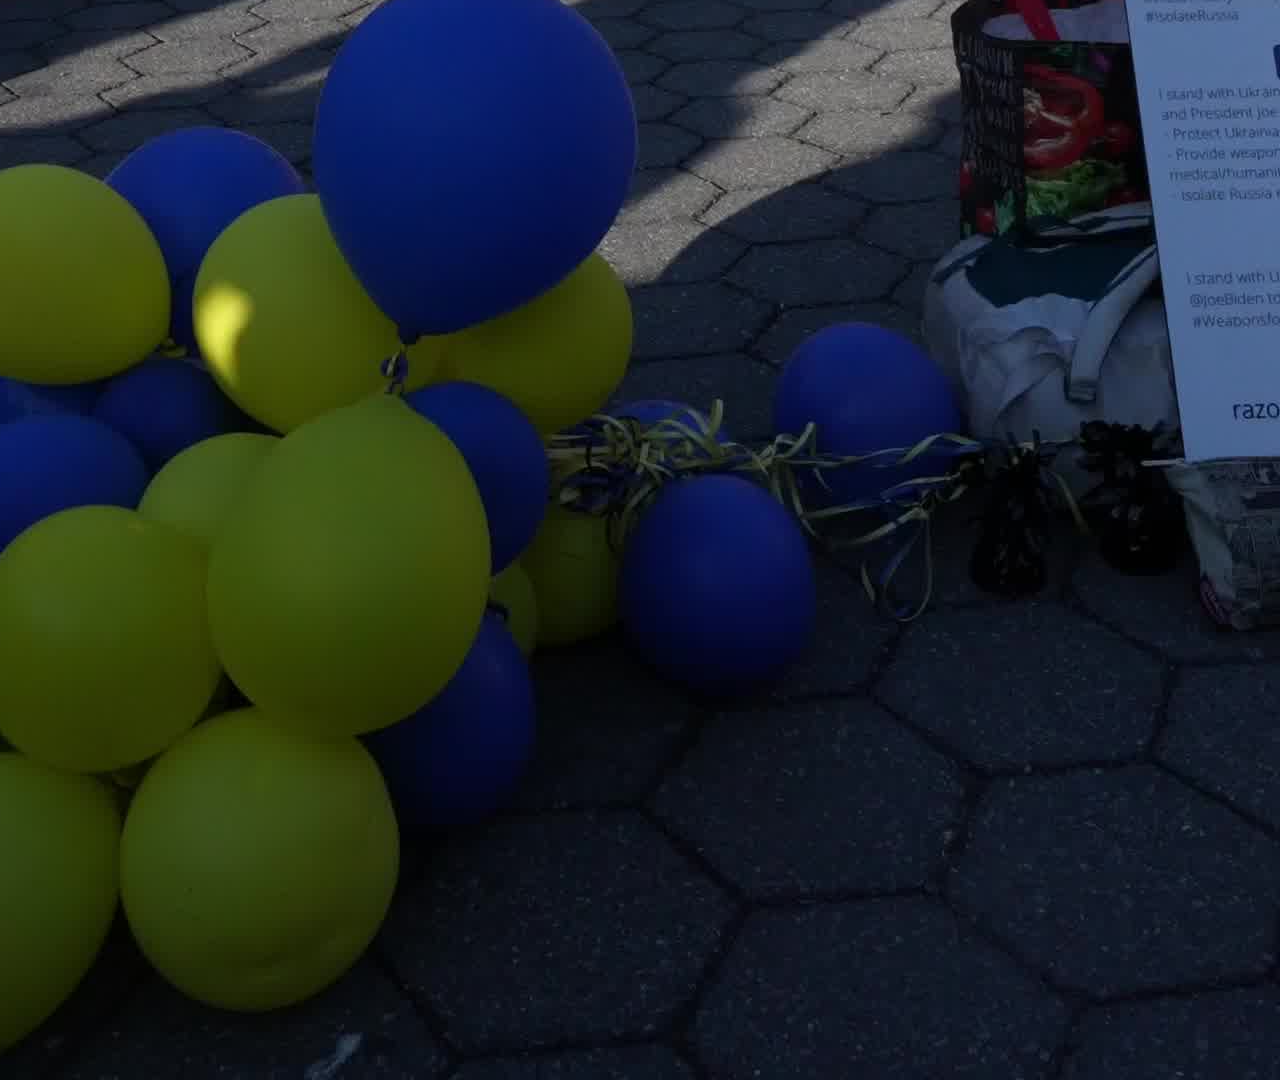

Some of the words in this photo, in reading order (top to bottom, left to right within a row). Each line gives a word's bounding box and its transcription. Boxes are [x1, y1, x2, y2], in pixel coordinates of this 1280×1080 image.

[1160, 105, 1187, 121] and
[1172, 127, 1222, 141] Protect
[1190, 271, 1233, 285] stand
[1234, 269, 1265, 284] with
